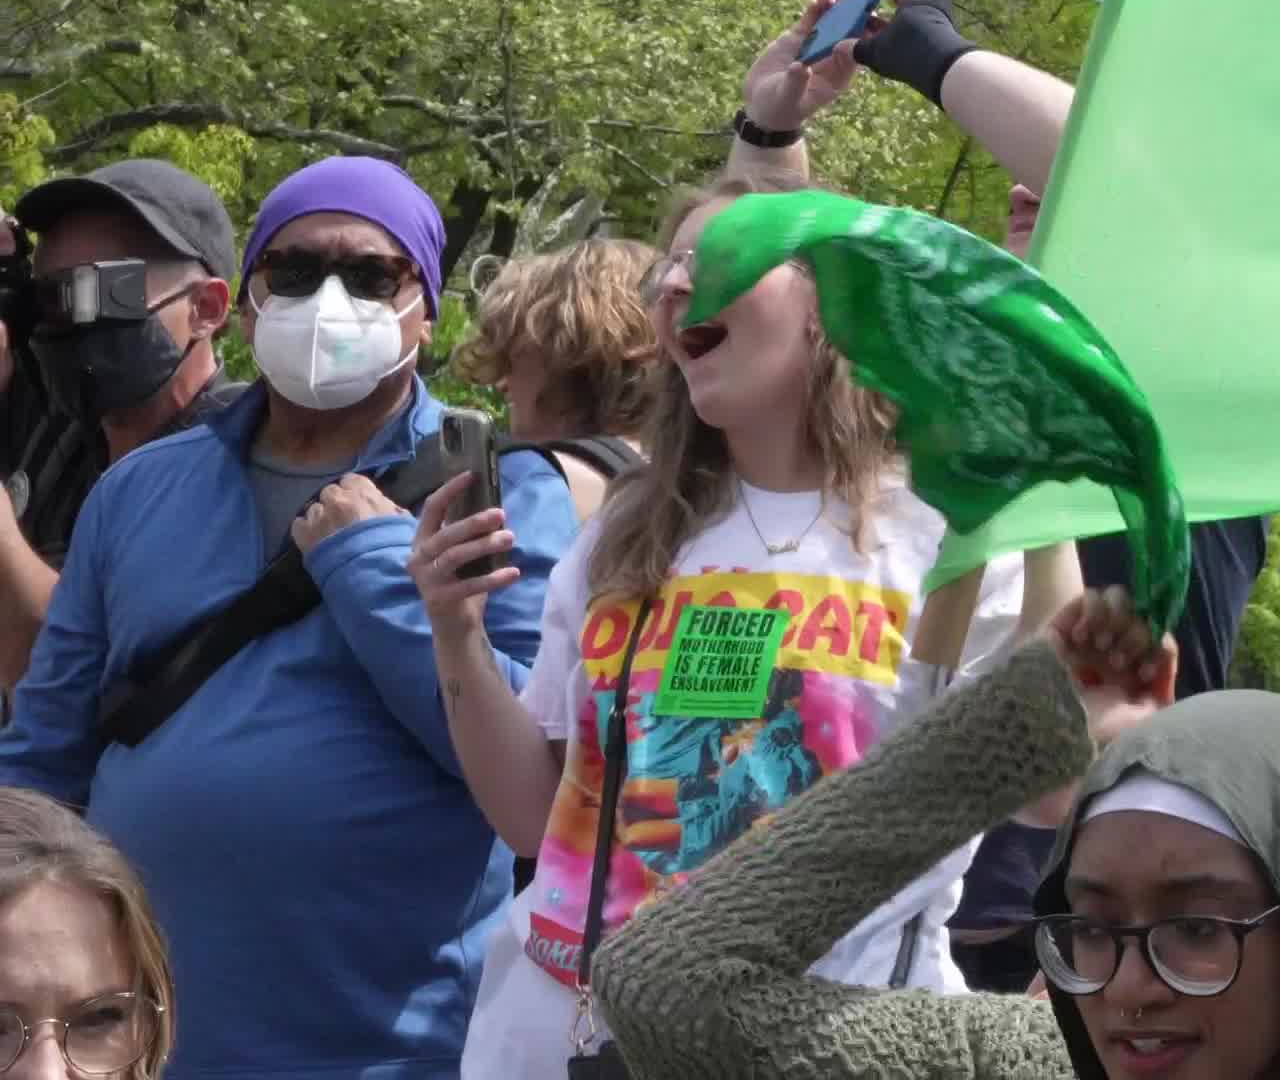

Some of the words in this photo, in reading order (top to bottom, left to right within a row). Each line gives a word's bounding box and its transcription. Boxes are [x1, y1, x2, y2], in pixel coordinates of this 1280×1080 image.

[686, 609, 777, 637] FORCED
[680, 638, 765, 655] MOTHERHOOD
[674, 654, 692, 674] IS
[696, 655, 763, 676] FEMALE
[670, 675, 758, 693] ENSLAVEMENT
